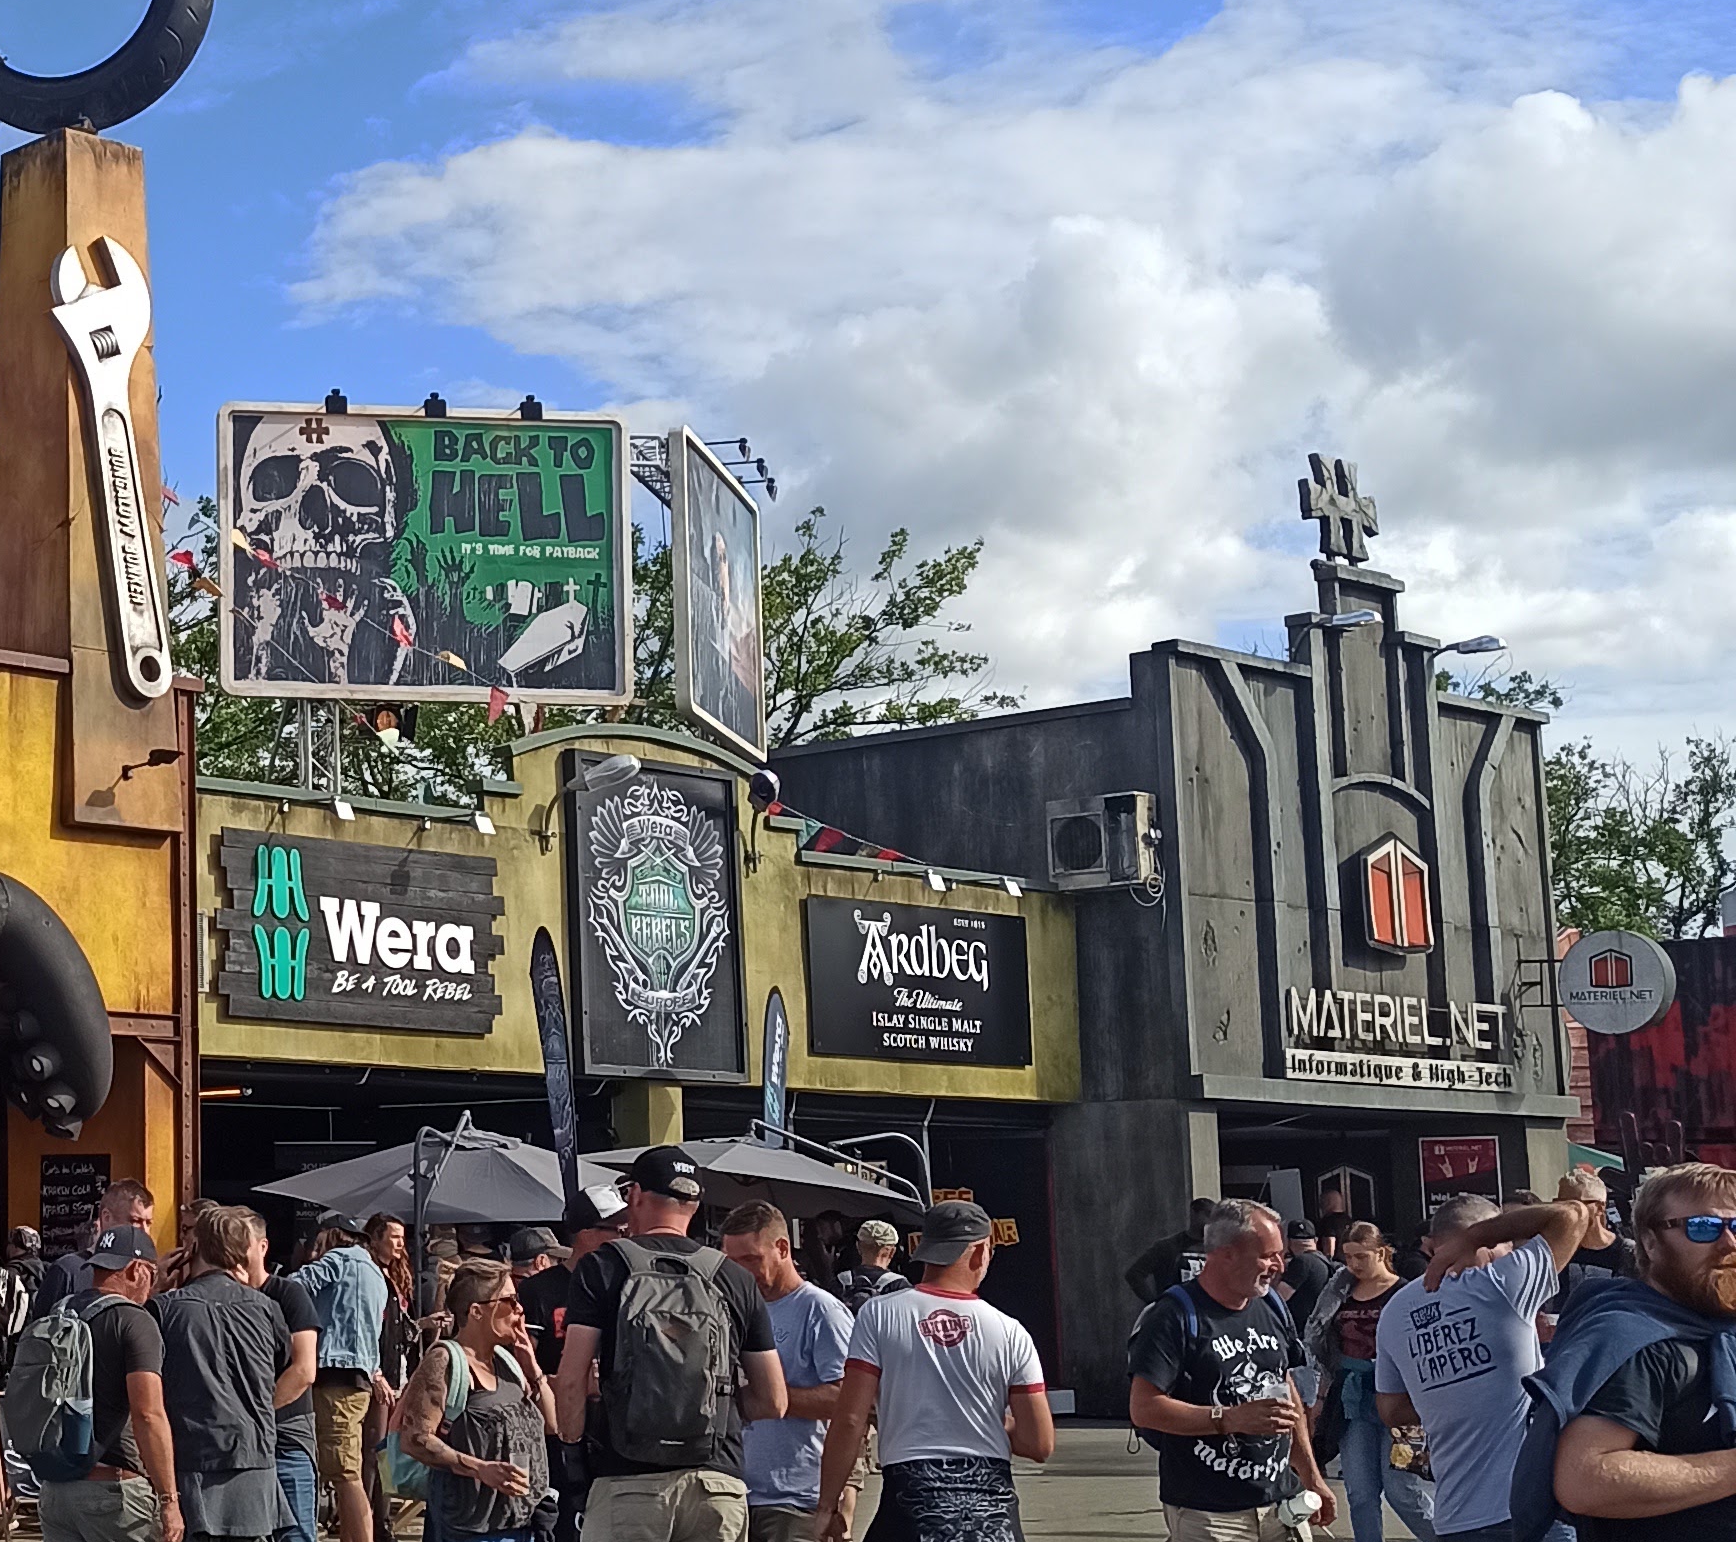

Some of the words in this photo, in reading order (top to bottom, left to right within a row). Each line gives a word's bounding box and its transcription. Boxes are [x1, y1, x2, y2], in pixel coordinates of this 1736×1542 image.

[433, 429, 540, 468] BACK
[548, 435, 596, 470] TO
[429, 469, 606, 544] HELL
[108, 446, 136, 539] BUNGALOW
[122, 544, 147, 606] BUNKER
[461, 542, 483, 555] IT'S
[488, 544, 514, 557] TIME
[519, 545, 541, 558] FOR
[546, 546, 600, 559] PAYBACK
[638, 818, 674, 837] Wera
[638, 883, 679, 912] TOOL
[319, 895, 476, 975] Wera
[630, 914, 692, 958] REBELS
[331, 970, 361, 994] BE
[361, 974, 377, 993] A
[382, 974, 418, 997] TOOL
[422, 978, 473, 1002] REBEL
[893, 987, 915, 1008] The
[913, 989, 963, 1012] Ultimate
[1569, 989, 1654, 1001] MATERIEL.NET
[872, 1011, 905, 1028] ISLAY
[908, 1013, 949, 1031] SINGLE
[952, 1017, 983, 1034] MALT
[1290, 986, 1508, 1050] MATERIEL.NET
[882, 1032, 926, 1049] SCOTCH
[928, 1036, 974, 1052] WHISKY
[1290, 1053, 1404, 1083] Informatique
[1411, 1061, 1422, 1082] &
[1428, 1063, 1513, 1089] High-Tech
[1212, 1333, 1245, 1362] We
[1246, 1327, 1279, 1355] Are
[1408, 1316, 1482, 1359] LIBÉREZ
[1416, 1342, 1492, 1384] L'APÉRO
